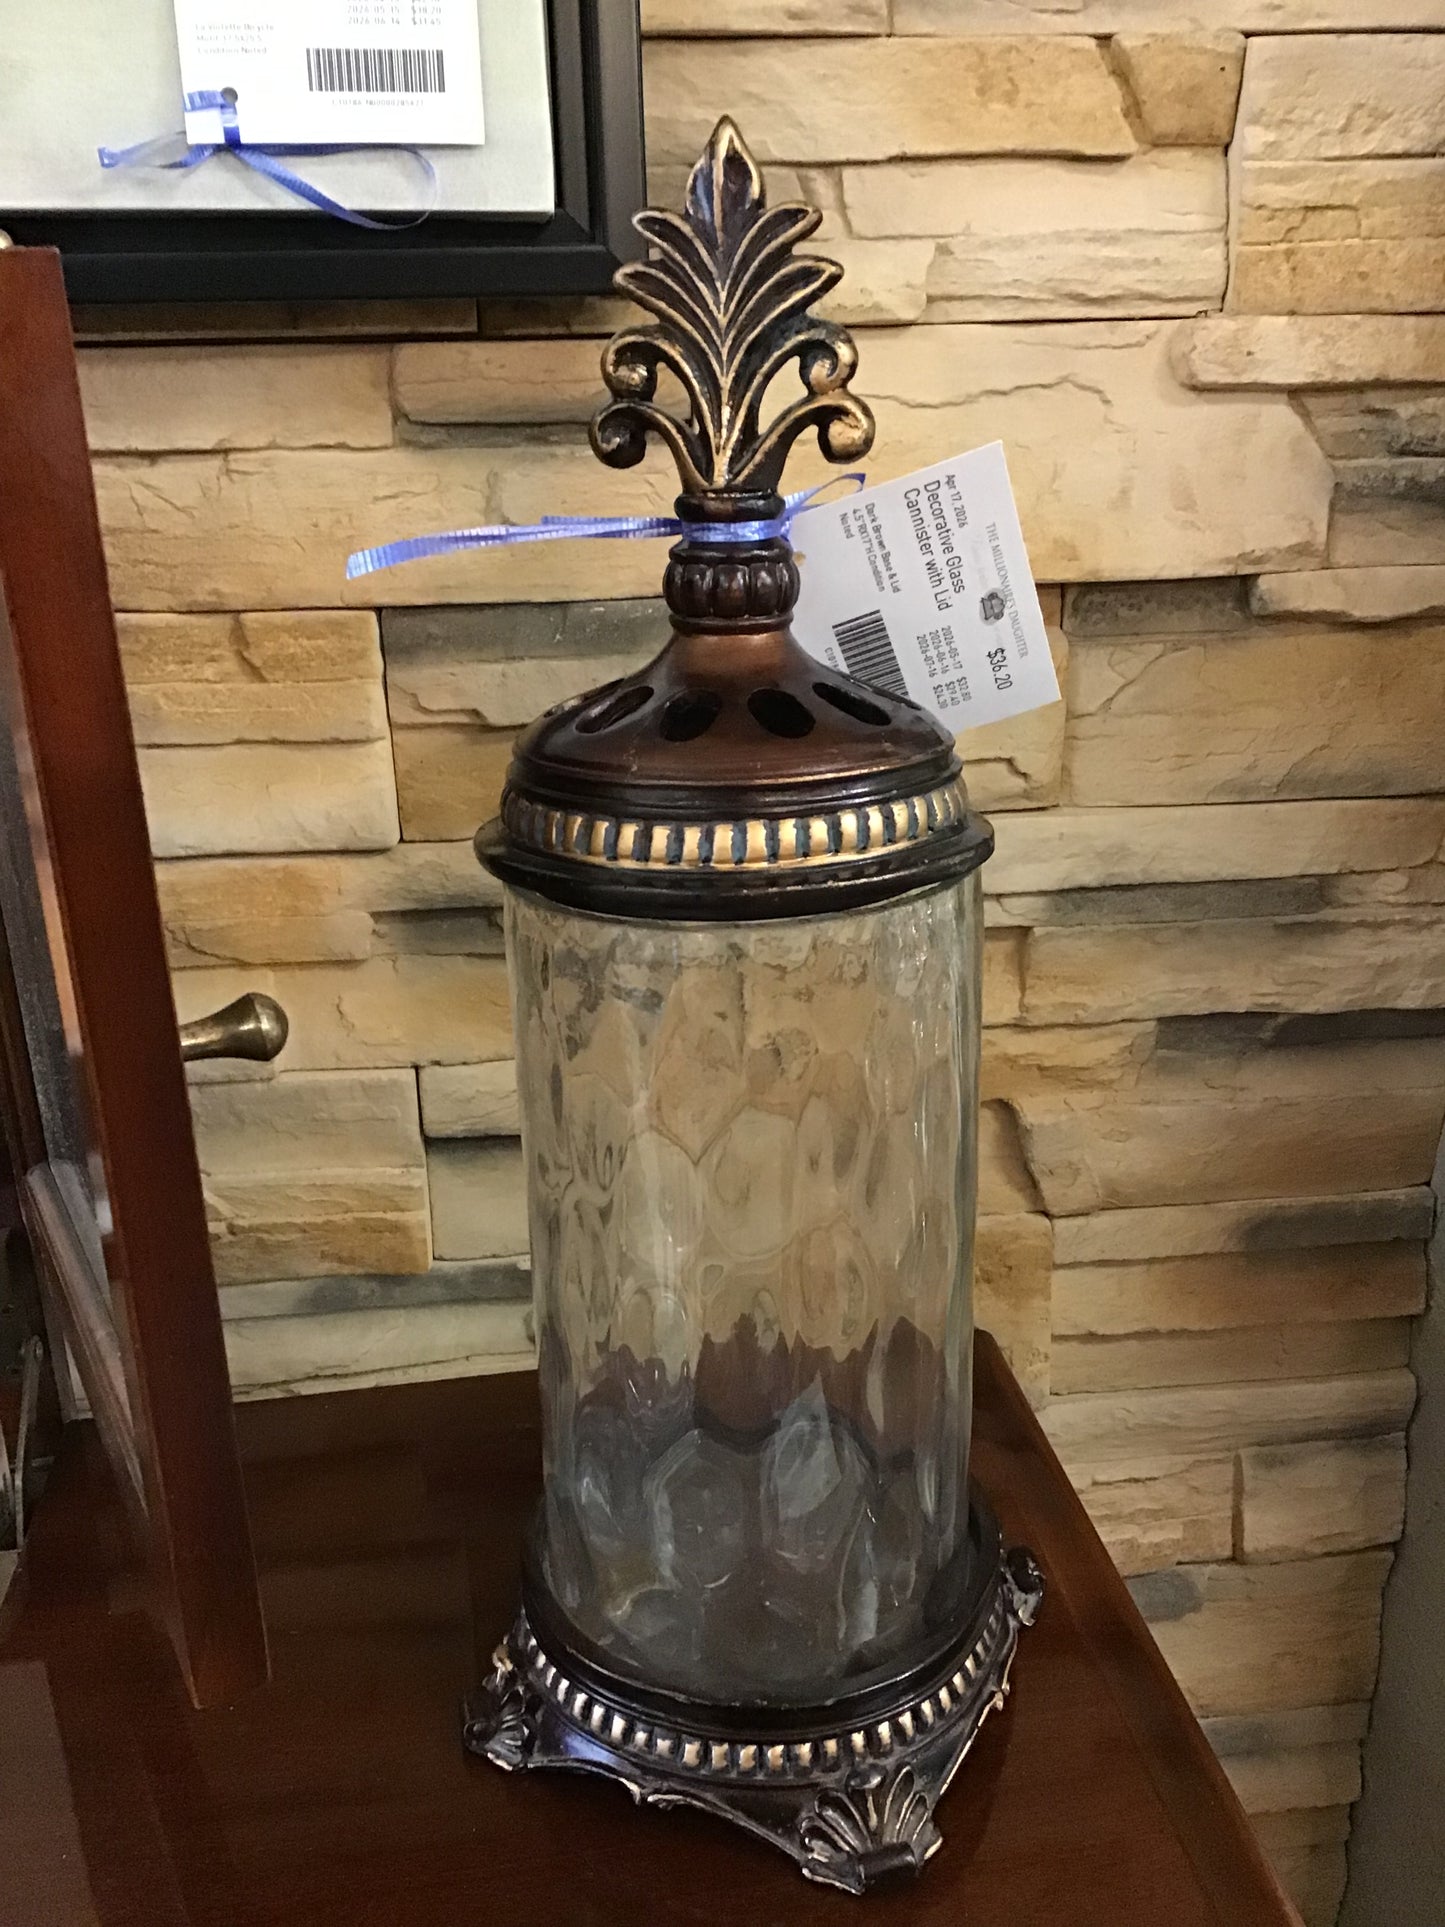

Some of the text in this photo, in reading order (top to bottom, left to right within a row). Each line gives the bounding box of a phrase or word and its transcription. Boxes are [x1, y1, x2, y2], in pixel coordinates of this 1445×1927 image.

[864, 502, 879, 523] Dark
[944, 473, 957, 490] Apr
[953, 504, 968, 529] 2026
[838, 512, 854, 539] Noted
[871, 523, 889, 552] Brown
[923, 479, 968, 594] Decorative Glass
[880, 551, 895, 572] Base
[902, 487, 953, 611] Cannister with Lid
[867, 553, 887, 592] Condition
[889, 579, 902, 594] Lid
[985, 522, 999, 543] THE
[1007, 610, 1028, 658] DAUGHTER
[915, 633, 938, 678] 2026-07-16
[928, 629, 950, 674] 2026-06-16
[940, 624, 963, 670] 2026-05-17
[985, 646, 1013, 691] $36.20
